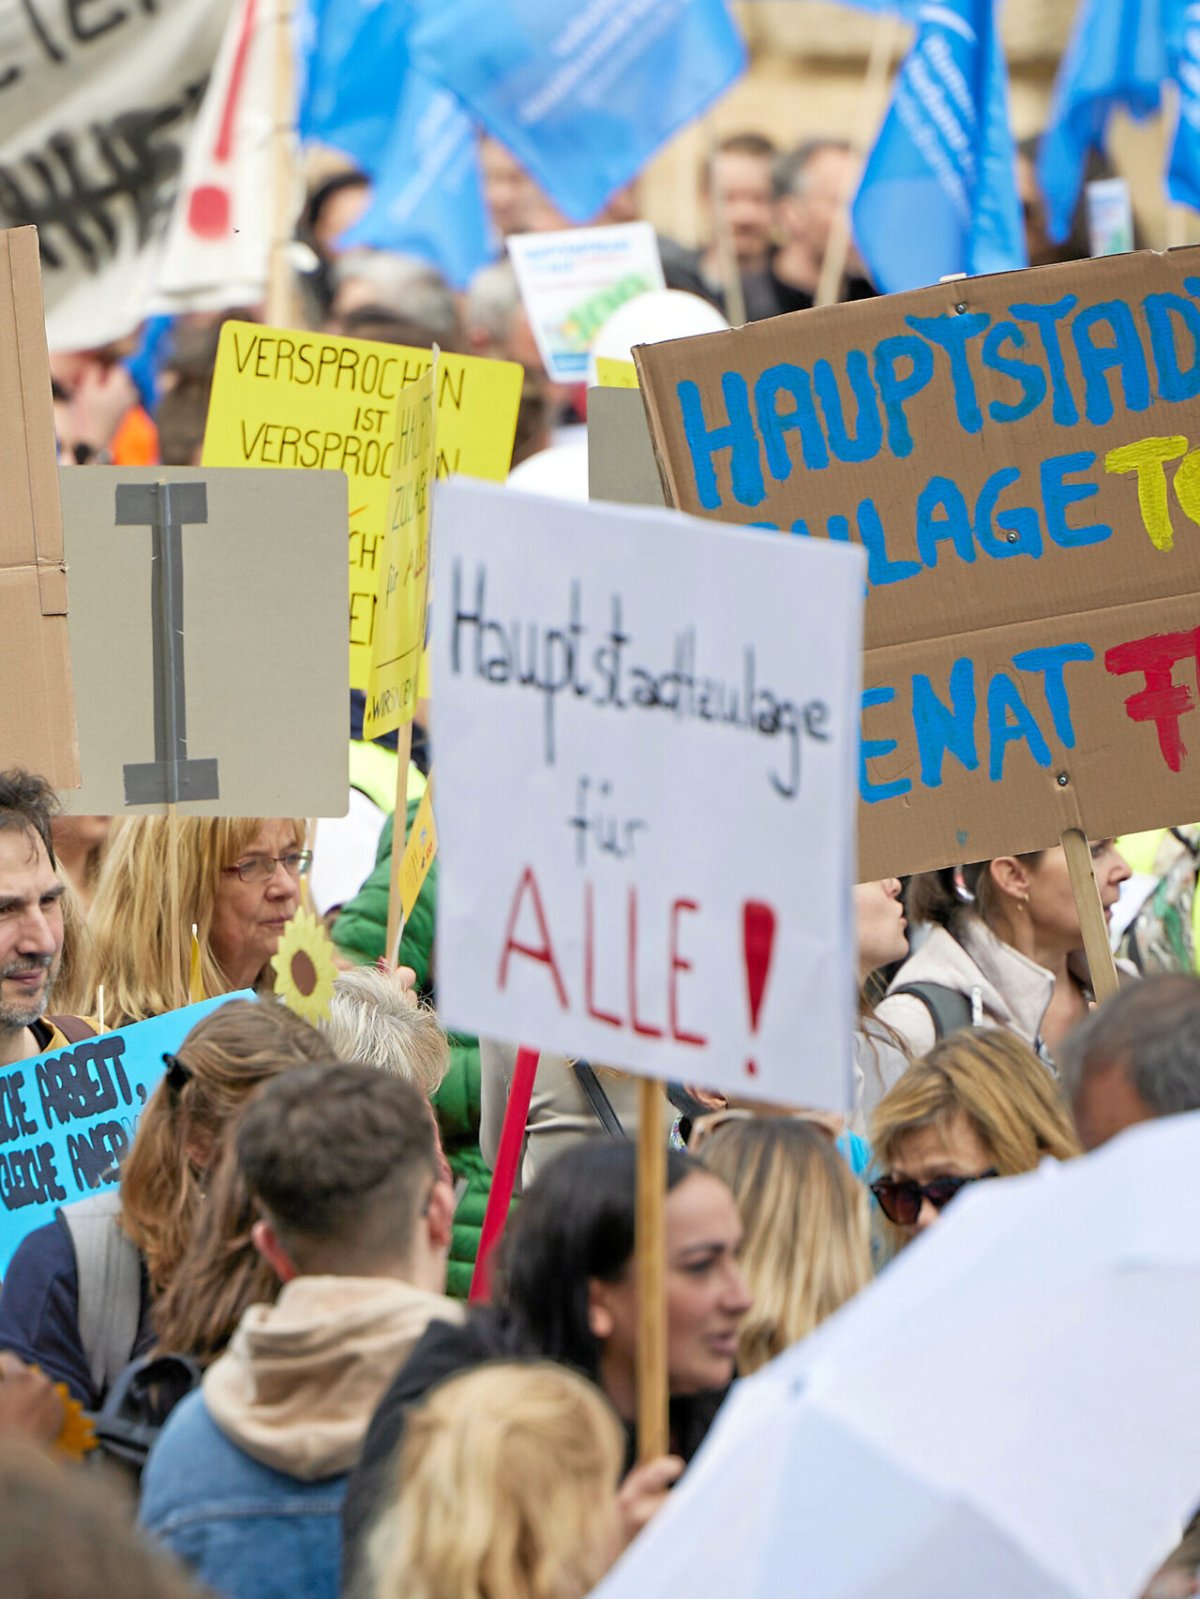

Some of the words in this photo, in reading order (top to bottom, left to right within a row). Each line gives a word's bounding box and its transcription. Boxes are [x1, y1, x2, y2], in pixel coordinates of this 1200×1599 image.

[233, 332, 466, 411] VERSPROCHN
[354, 406, 390, 434] IST
[676, 275, 1200, 510] HAUPTSTAD
[450, 556, 831, 799] Hauptstadtzulage
[858, 641, 1095, 804] ENAT
[567, 776, 648, 867] für
